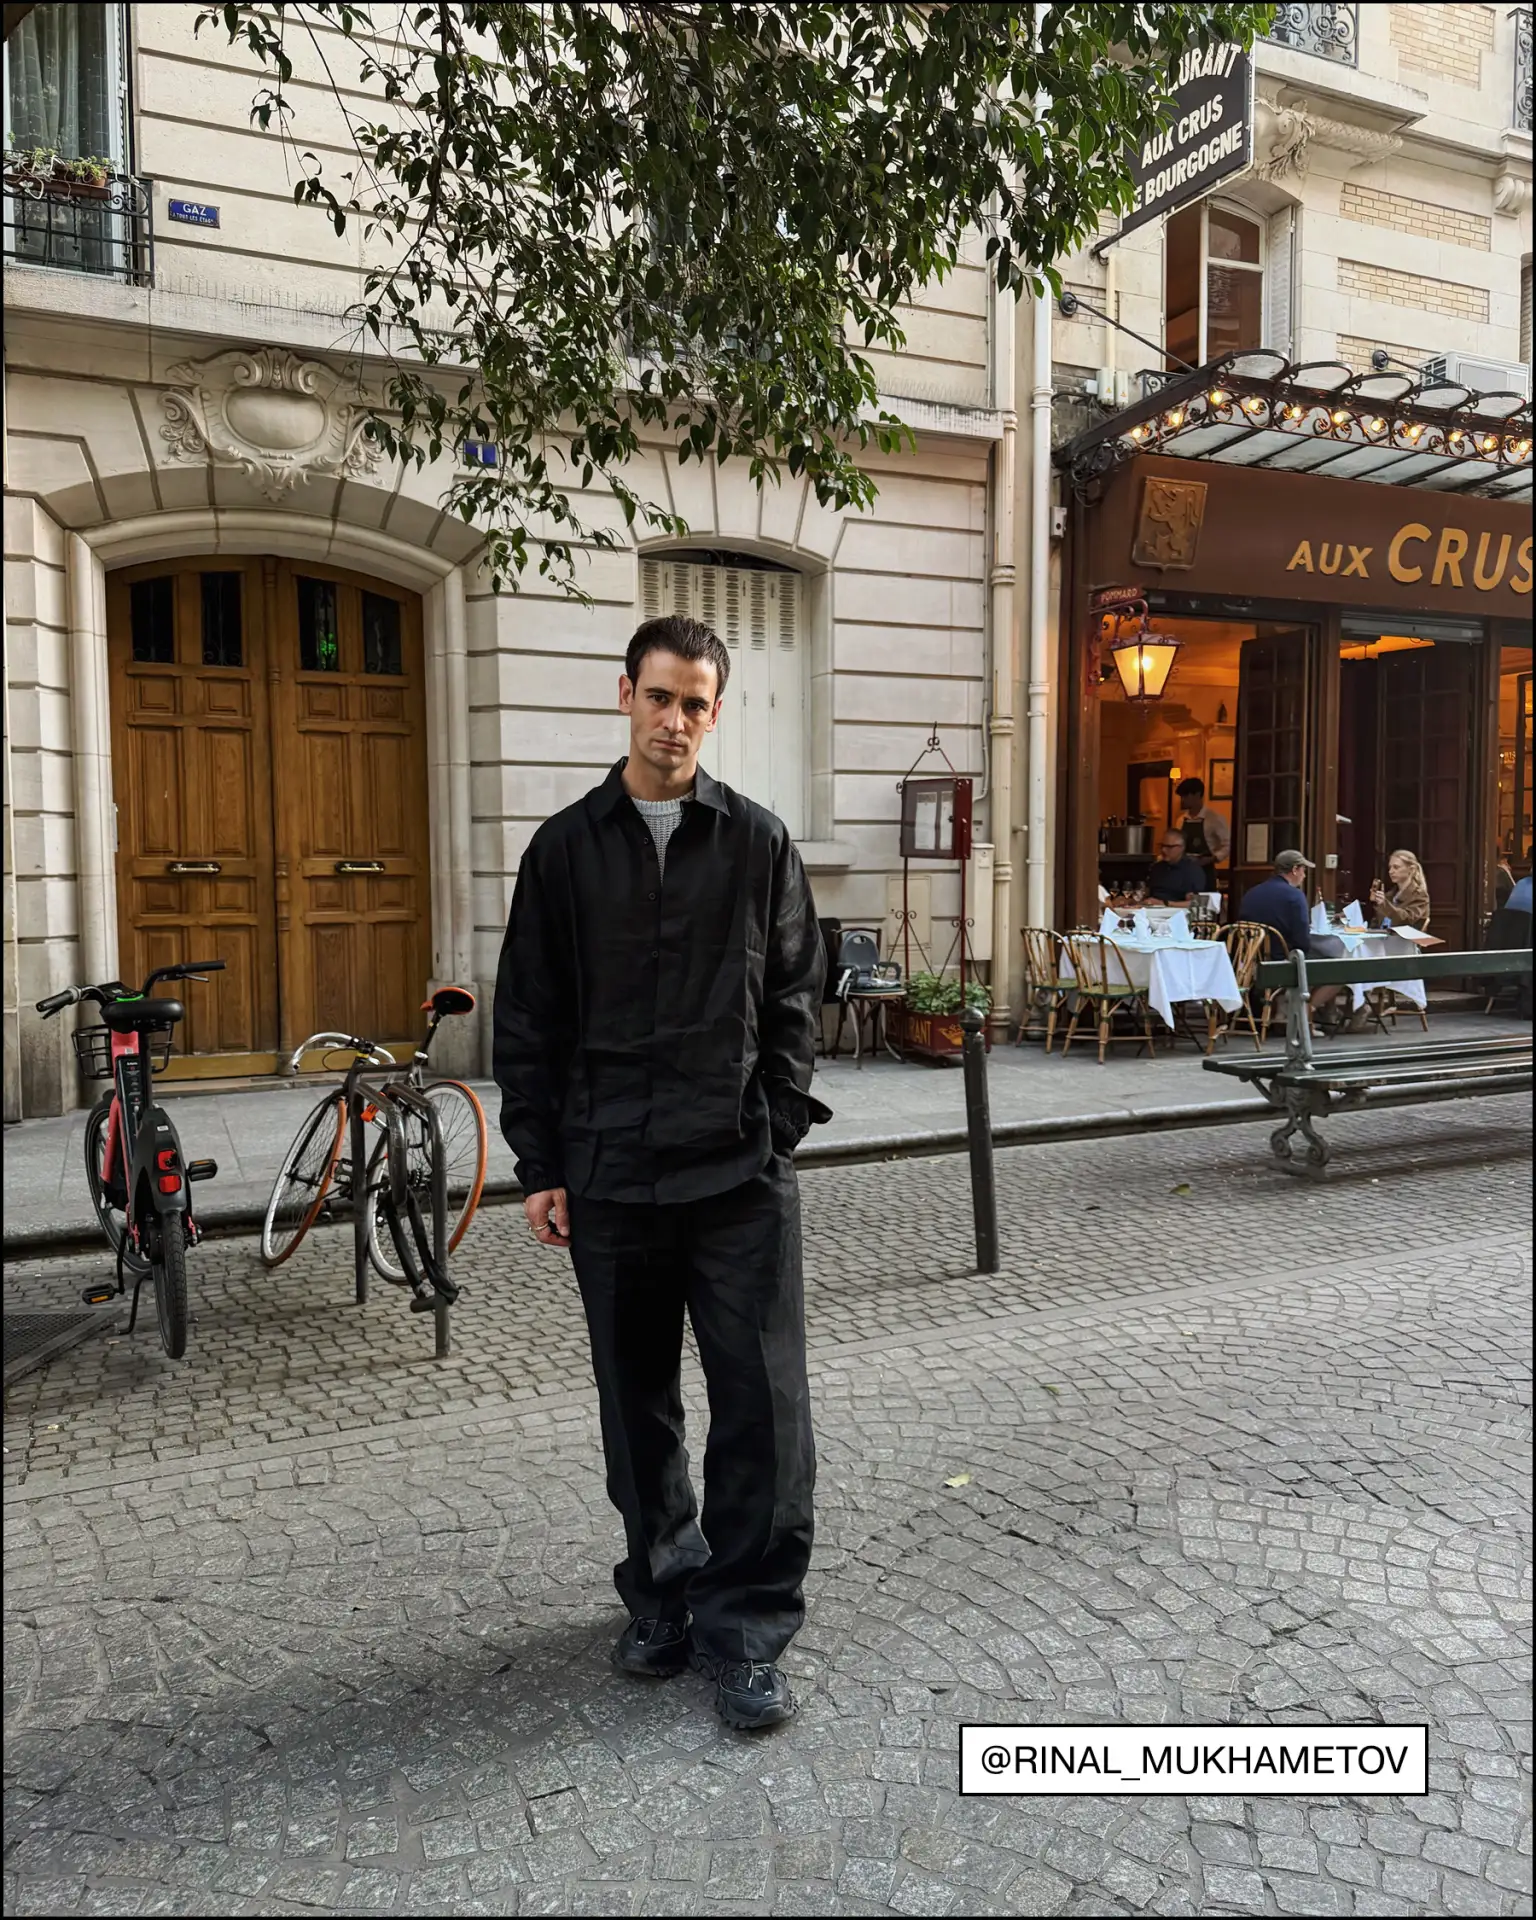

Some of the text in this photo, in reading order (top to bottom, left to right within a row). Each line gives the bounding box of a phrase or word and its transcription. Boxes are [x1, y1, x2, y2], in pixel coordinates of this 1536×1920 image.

[1141, 94, 1223, 169] AUX CRUS
[1145, 120, 1243, 206] BOURGOGNE
[183, 203, 207, 216] GAZ
[1286, 523, 1532, 593] AUX CRUS
[1101, 588, 1138, 603] POMMARD
